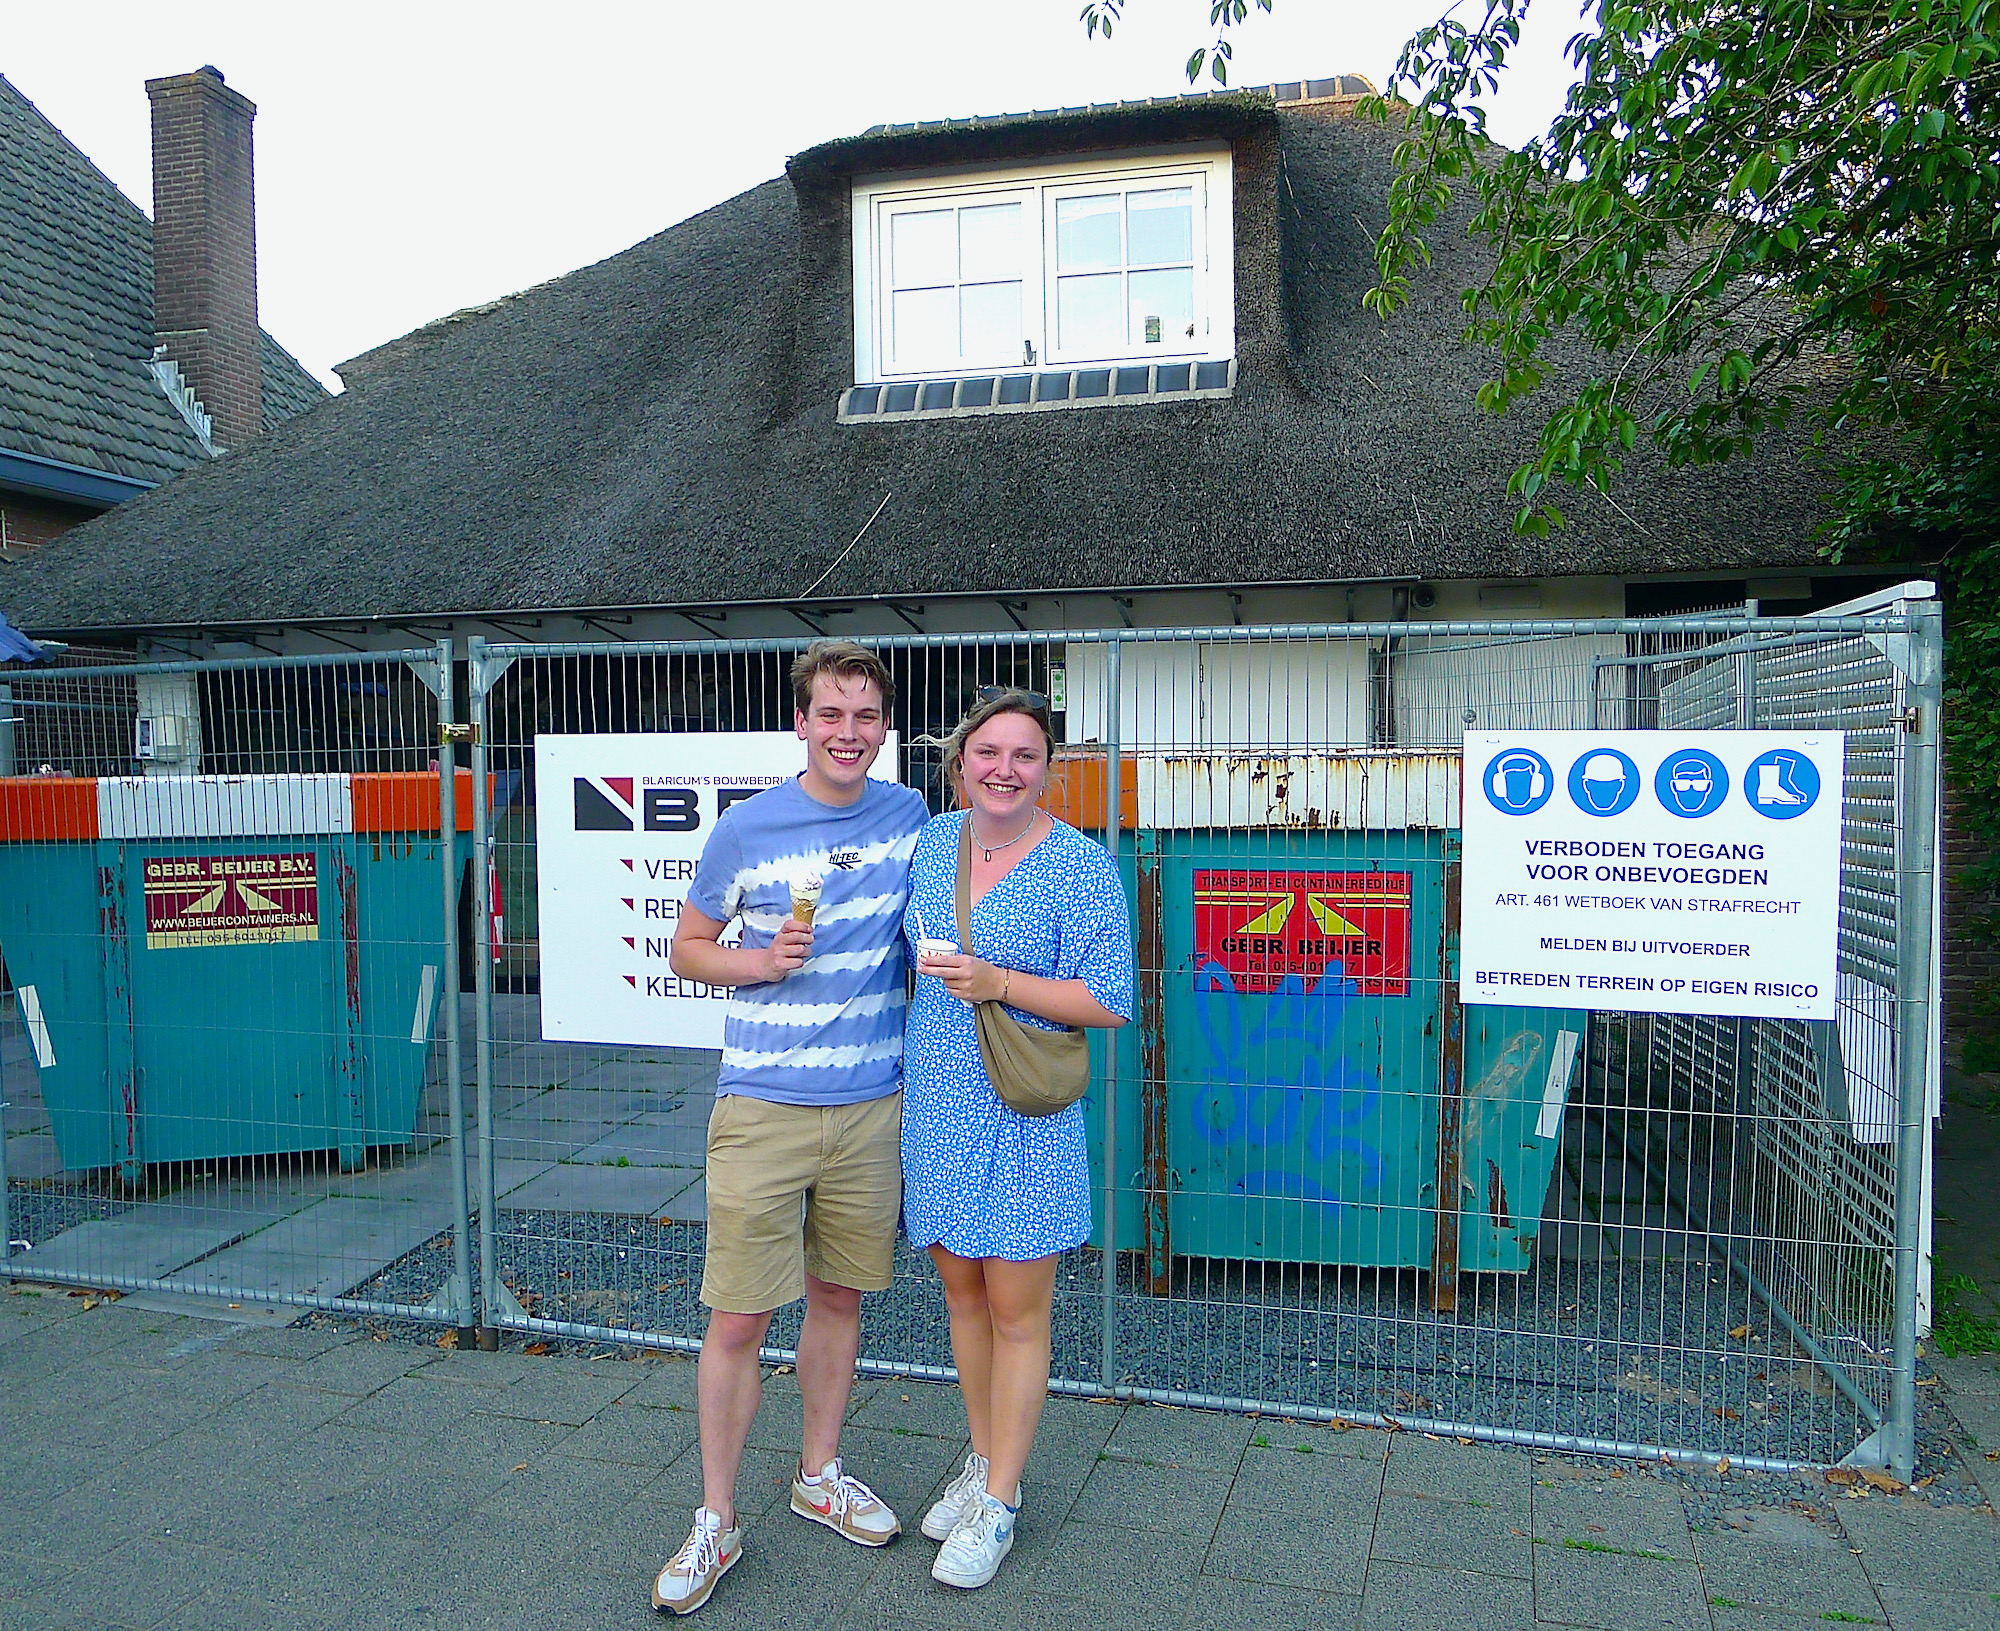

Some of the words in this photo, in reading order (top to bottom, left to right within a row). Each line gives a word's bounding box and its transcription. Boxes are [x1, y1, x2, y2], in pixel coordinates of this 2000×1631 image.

[642, 776, 711, 786] BLARICUM'S
[829, 852, 859, 863] HI-TEC
[1525, 840, 1646, 858] VERBODEN
[1653, 842, 1765, 860] TOEGANG
[147, 862, 206, 877] GEBR.
[211, 860, 276, 875] BEIJER
[280, 858, 313, 872] B.V.
[1526, 864, 1589, 881] VOOR
[1595, 866, 1768, 885] ONBEVOEGDEN
[1274, 877, 1290, 889] EN
[1495, 893, 1529, 906] ART.
[1533, 894, 1559, 907] 461
[1564, 895, 1646, 909] WETBOEK
[1650, 897, 1682, 910] VAN
[1687, 898, 1802, 914] STRAFRECHT
[151, 913, 315, 929] WWW.BEIJERCONTAINERS.NL
[1221, 937, 1290, 955] GEBR.
[1298, 939, 1382, 956] BEIJER
[1540, 937, 1607, 951] MELDEN
[1612, 939, 1637, 952] BIJ
[1642, 940, 1751, 957] UITVOERDER
[1475, 971, 1571, 988] BETREDEN
[1575, 975, 1654, 991] TERREIN
[1660, 978, 1686, 992] OP
[1691, 980, 1748, 995] EIGEN
[1754, 982, 1819, 998] RISICO
